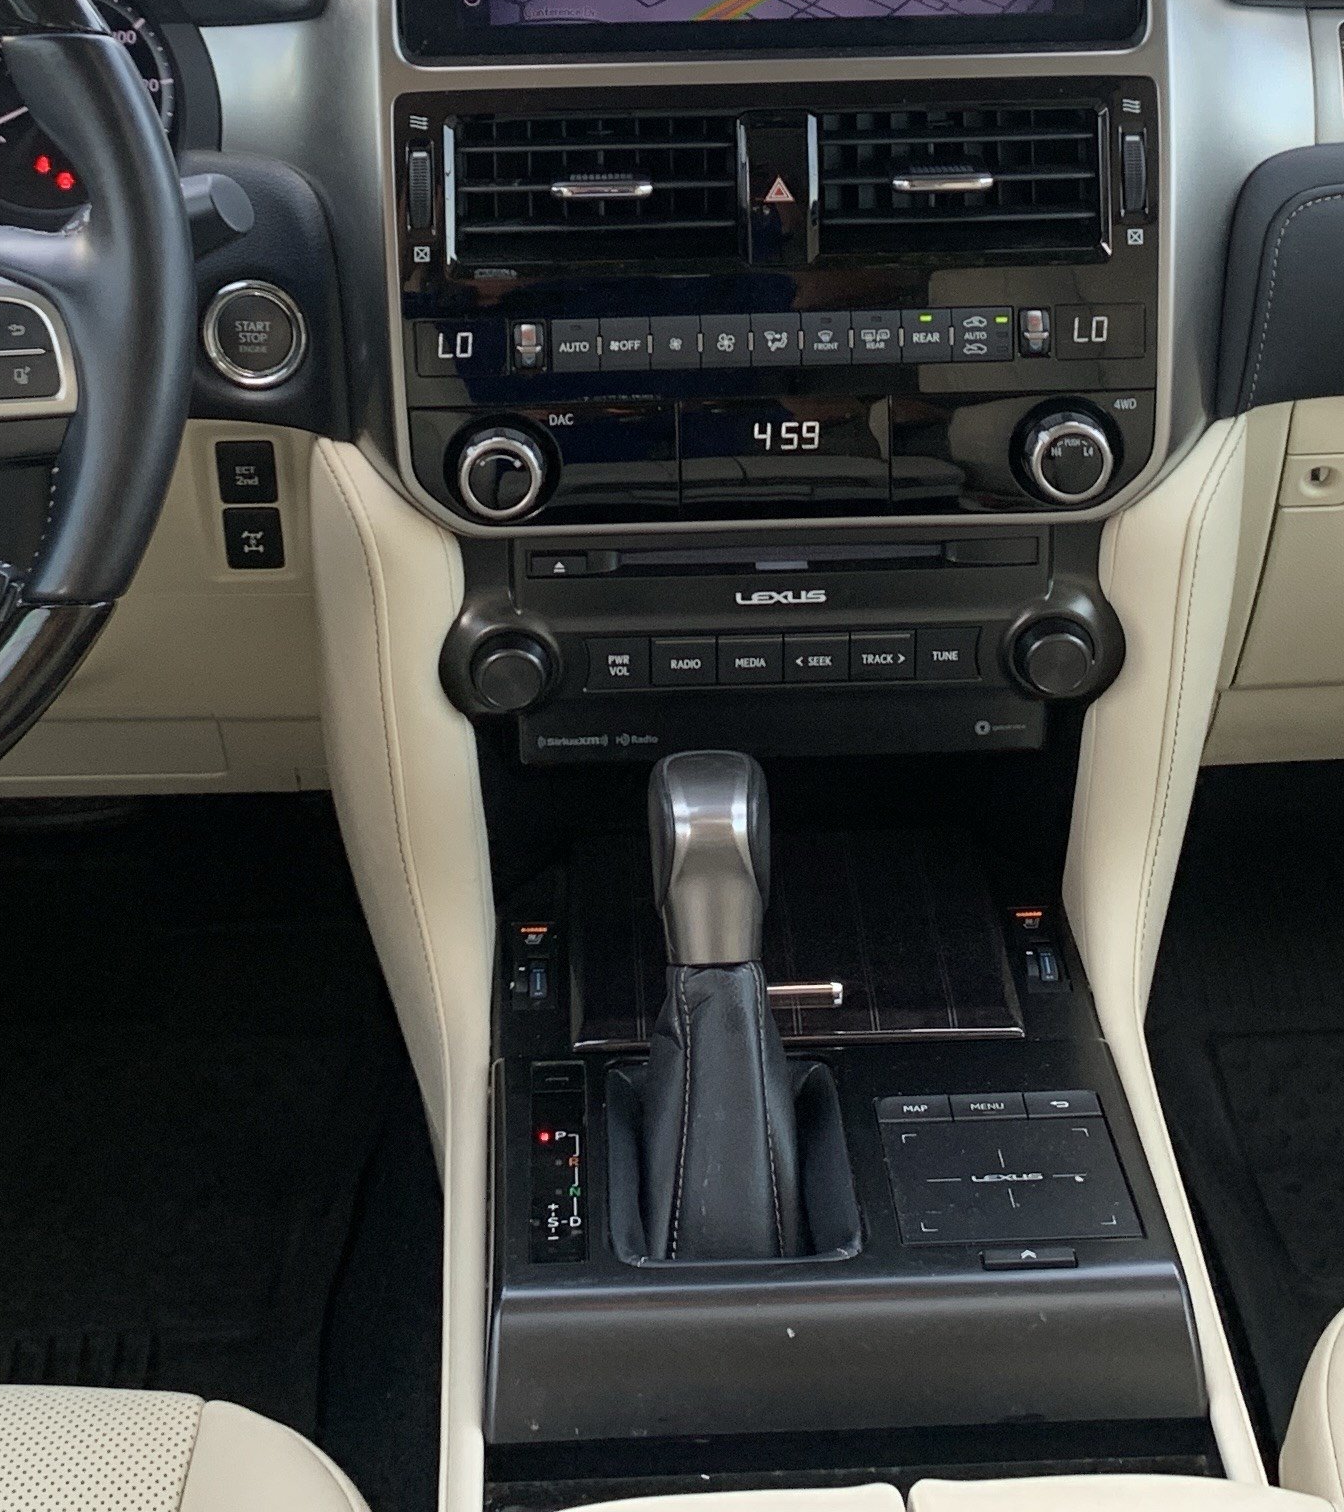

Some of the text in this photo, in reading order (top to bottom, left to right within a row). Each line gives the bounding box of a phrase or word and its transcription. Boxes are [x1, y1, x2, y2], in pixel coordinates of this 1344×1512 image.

[234, 321, 272, 332] START
[1072, 315, 1109, 344] LO
[238, 333, 268, 344] STOP
[912, 332, 940, 344] REAR
[963, 331, 988, 340] AUTO
[437, 331, 474, 359] LO
[558, 341, 590, 353] AUTO
[619, 339, 641, 351] OFF
[813, 342, 839, 351] FRONT
[865, 341, 886, 350] REAR
[1113, 398, 1138, 410] 4WD
[548, 413, 574, 426] DAC
[234, 466, 256, 475] ECT
[234, 476, 259, 486] 2nd
[735, 589, 827, 605] LEXUS
[608, 654, 630, 666] PWR
[807, 655, 833, 667] SEEK
[861, 653, 894, 665] TRACK
[932, 650, 959, 662] TUNE
[670, 658, 702, 670] RADIO
[734, 657, 766, 668] MEDIA
[608, 666, 630, 677] VOL
[630, 734, 659, 745] Radio
[902, 1104, 928, 1113] MAP
[969, 1102, 1005, 1111] MENU
[554, 1130, 567, 1141] P
[568, 1156, 580, 1166] R
[971, 1172, 1044, 1182] LEXUS
[568, 1185, 582, 1197] N
[568, 1215, 582, 1228] D
